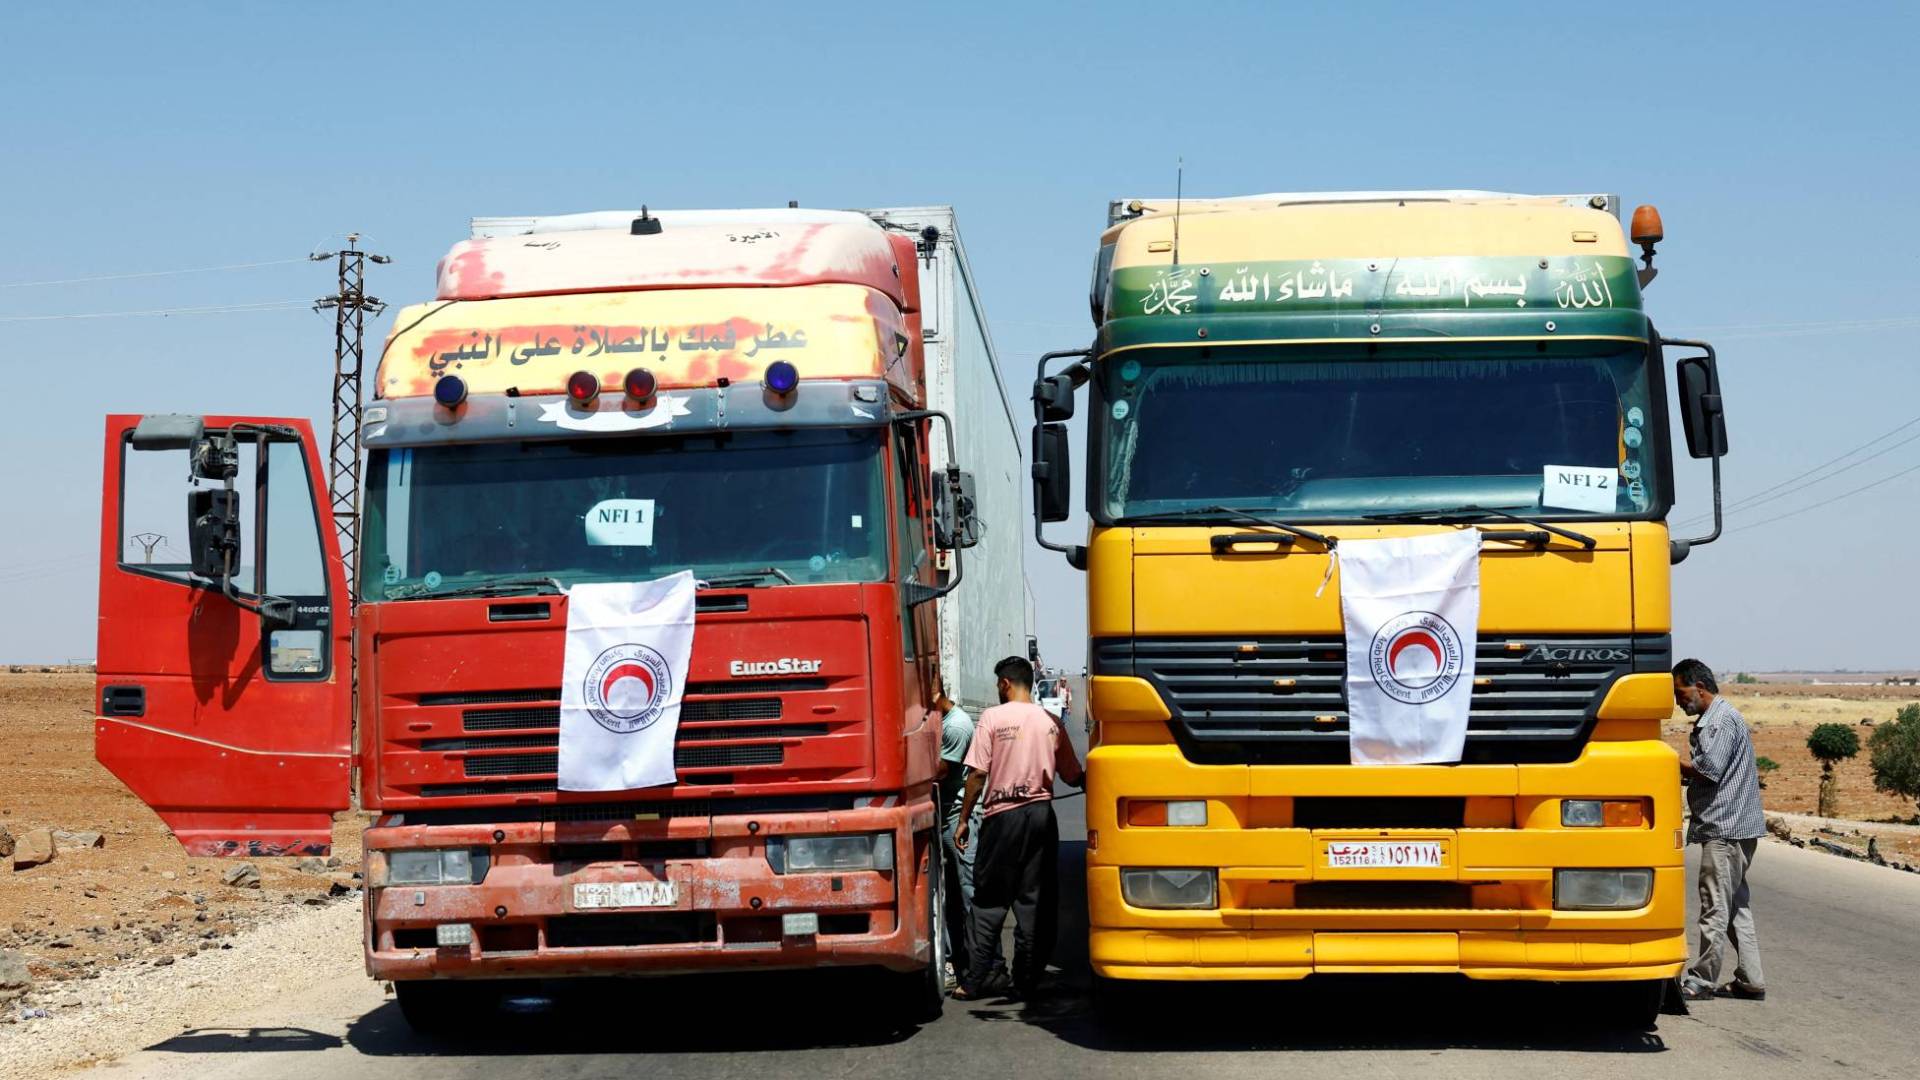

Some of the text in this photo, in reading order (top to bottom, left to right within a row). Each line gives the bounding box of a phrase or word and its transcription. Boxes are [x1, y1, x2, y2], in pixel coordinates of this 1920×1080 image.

[1464, 274, 1526, 308] بسم
[429, 320, 807, 377] عطر فمك بالصلاة على النبي
[1558, 472, 1608, 489] NFI 2
[599, 508, 644, 523] NFI 1
[730, 658, 822, 675] EuroStar
[1373, 636, 1411, 699] Arab Red Crescent
